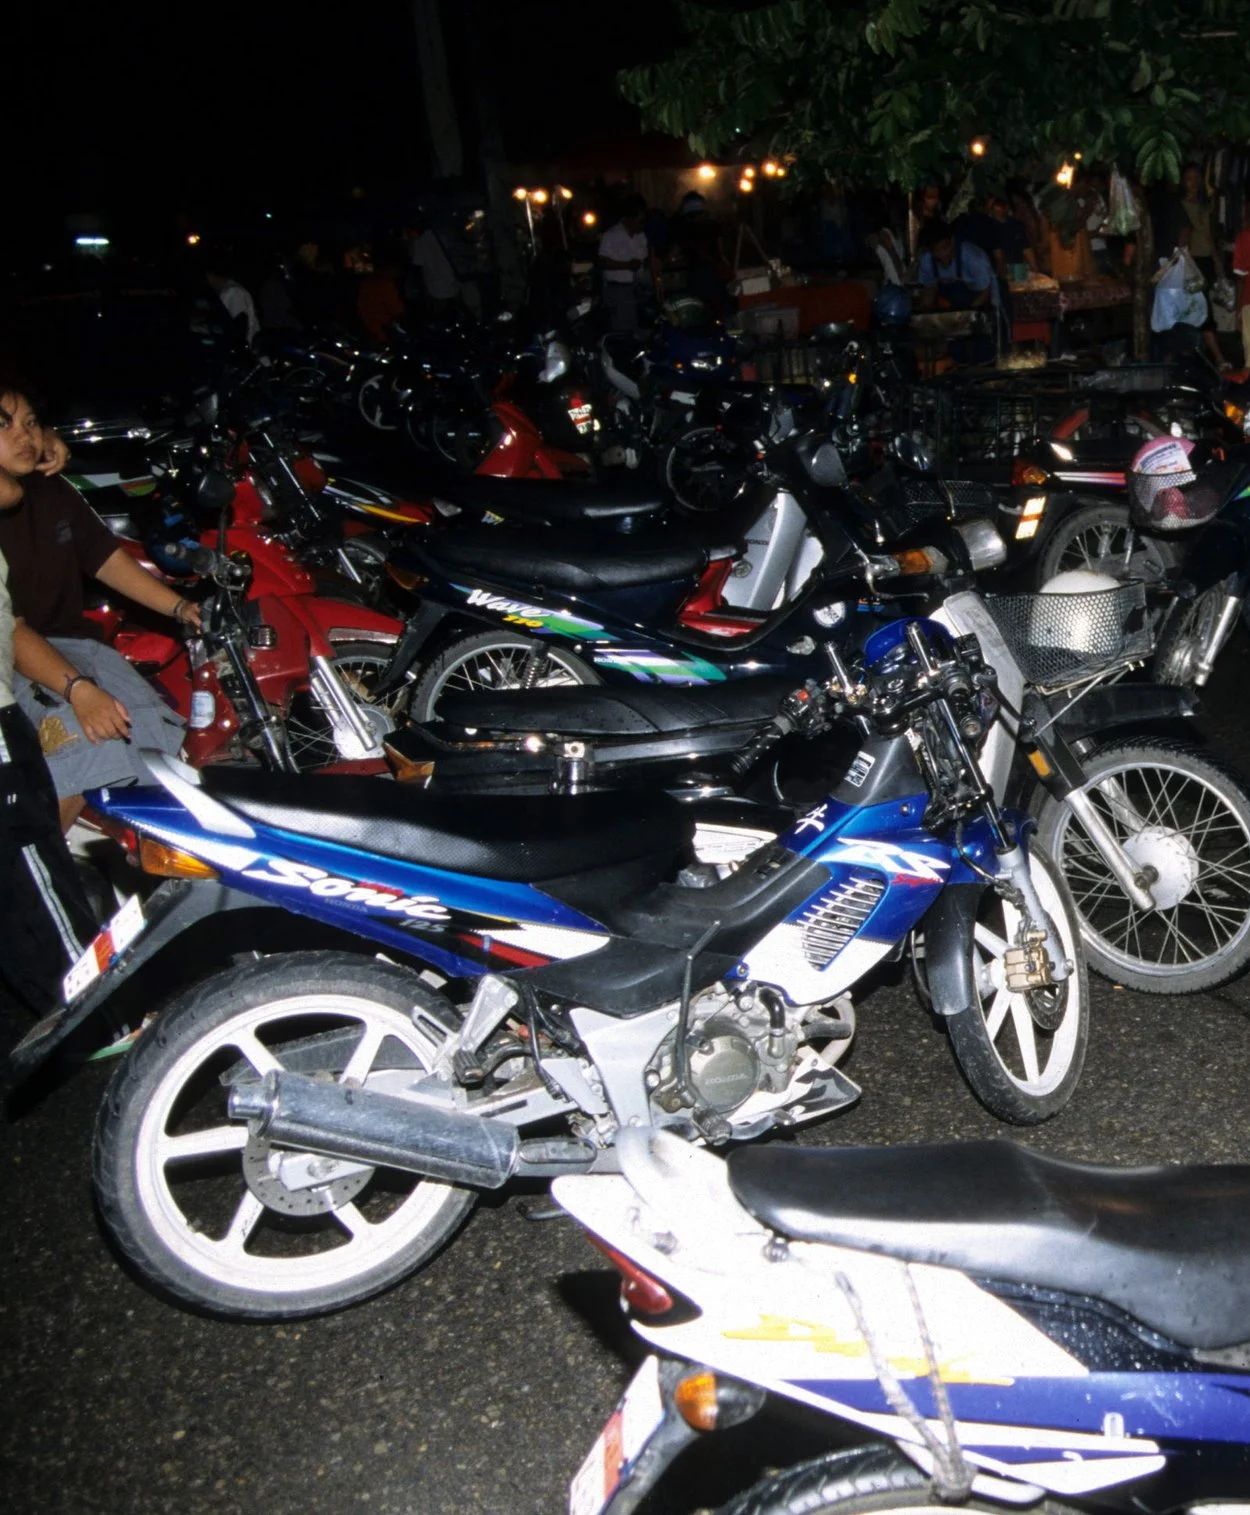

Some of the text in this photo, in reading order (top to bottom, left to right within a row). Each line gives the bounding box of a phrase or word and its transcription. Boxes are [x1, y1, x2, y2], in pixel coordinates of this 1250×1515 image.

[467, 588, 549, 618] Wave
[502, 614, 544, 628] 110
[242, 859, 451, 920] Sonic
[400, 917, 448, 933] 125
